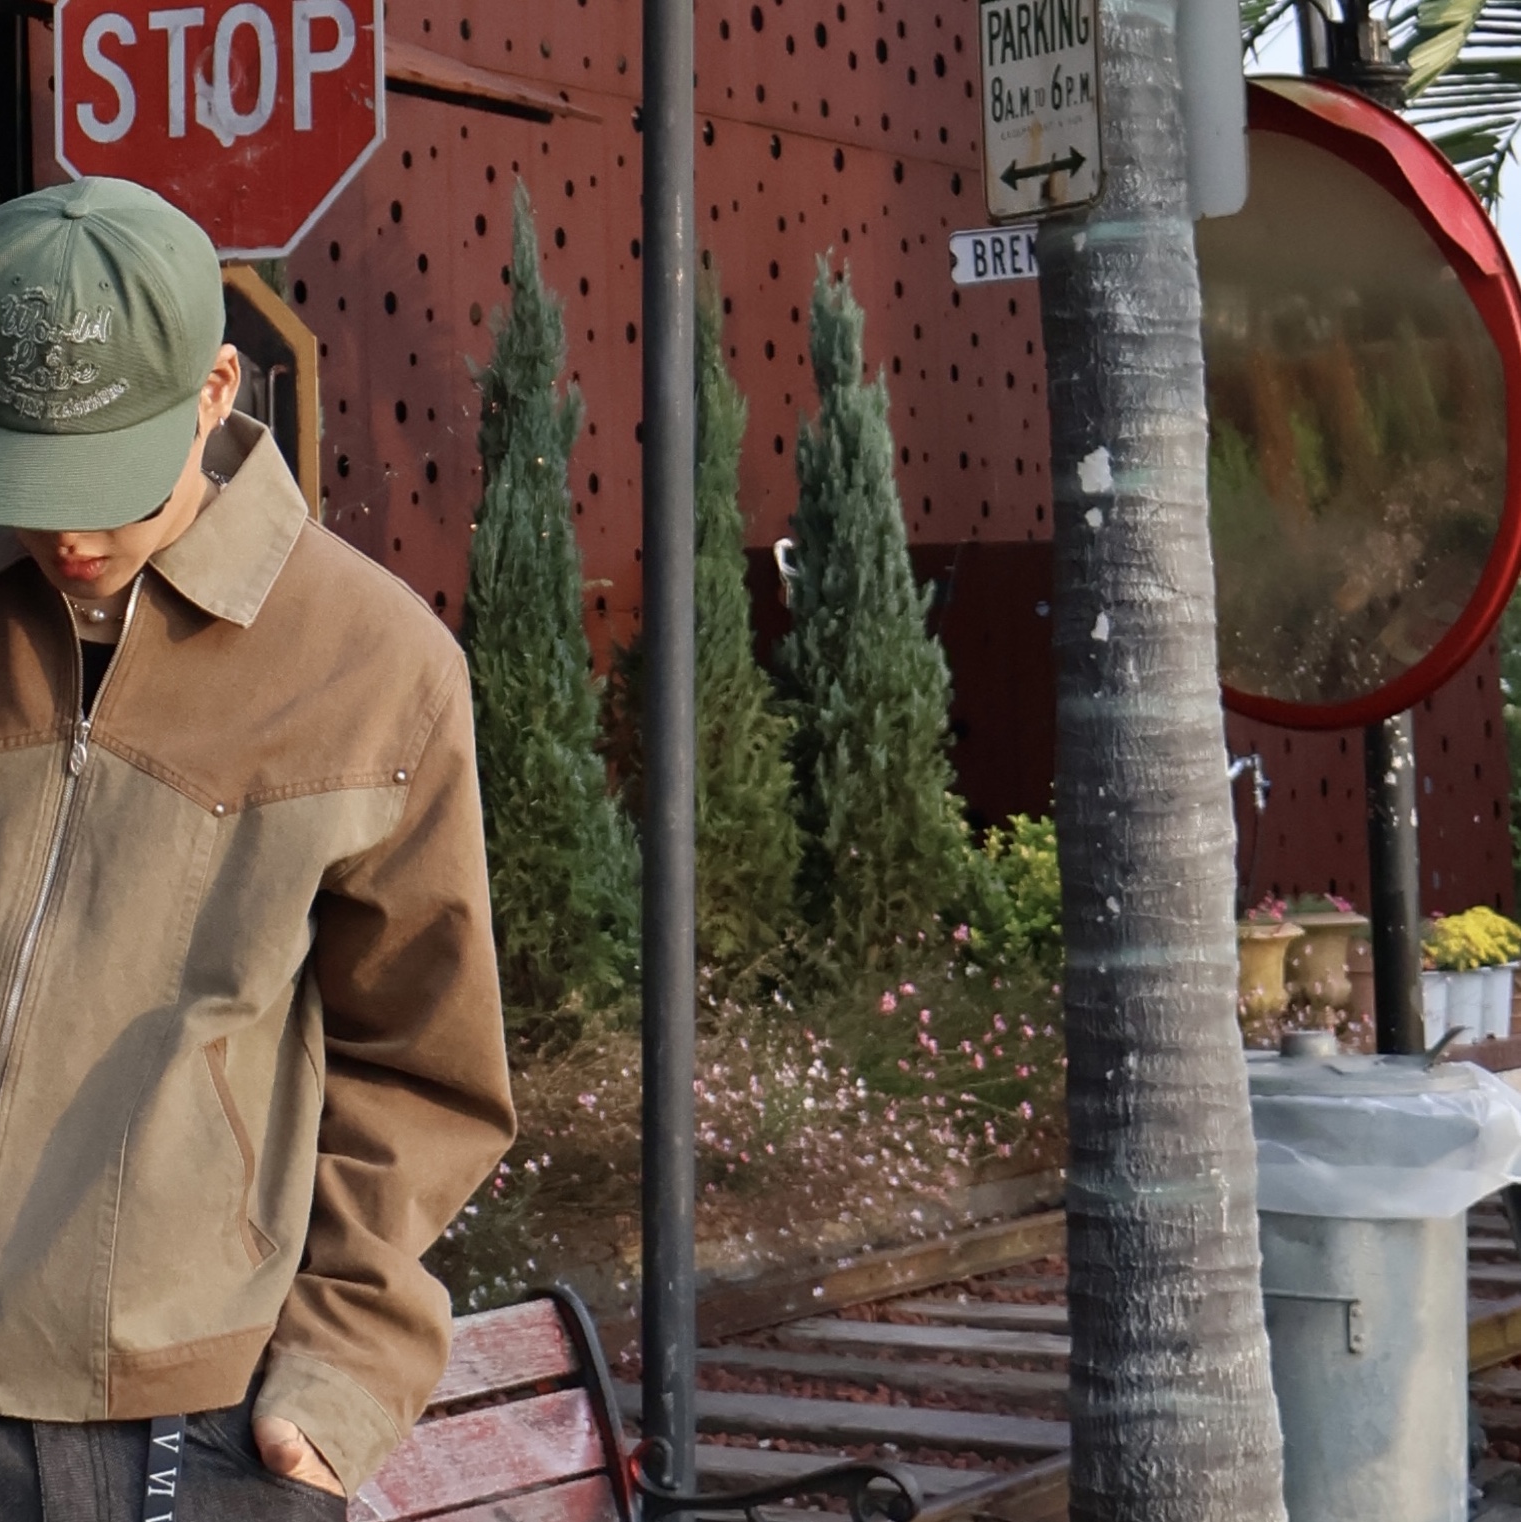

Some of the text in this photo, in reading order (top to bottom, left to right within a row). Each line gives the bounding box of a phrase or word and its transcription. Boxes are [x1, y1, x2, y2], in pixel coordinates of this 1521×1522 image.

[988, 0, 1089, 66] PARKING
[76, 0, 356, 143] STOP
[152, 1431, 180, 1453] V
[147, 1467, 177, 1497] VI
